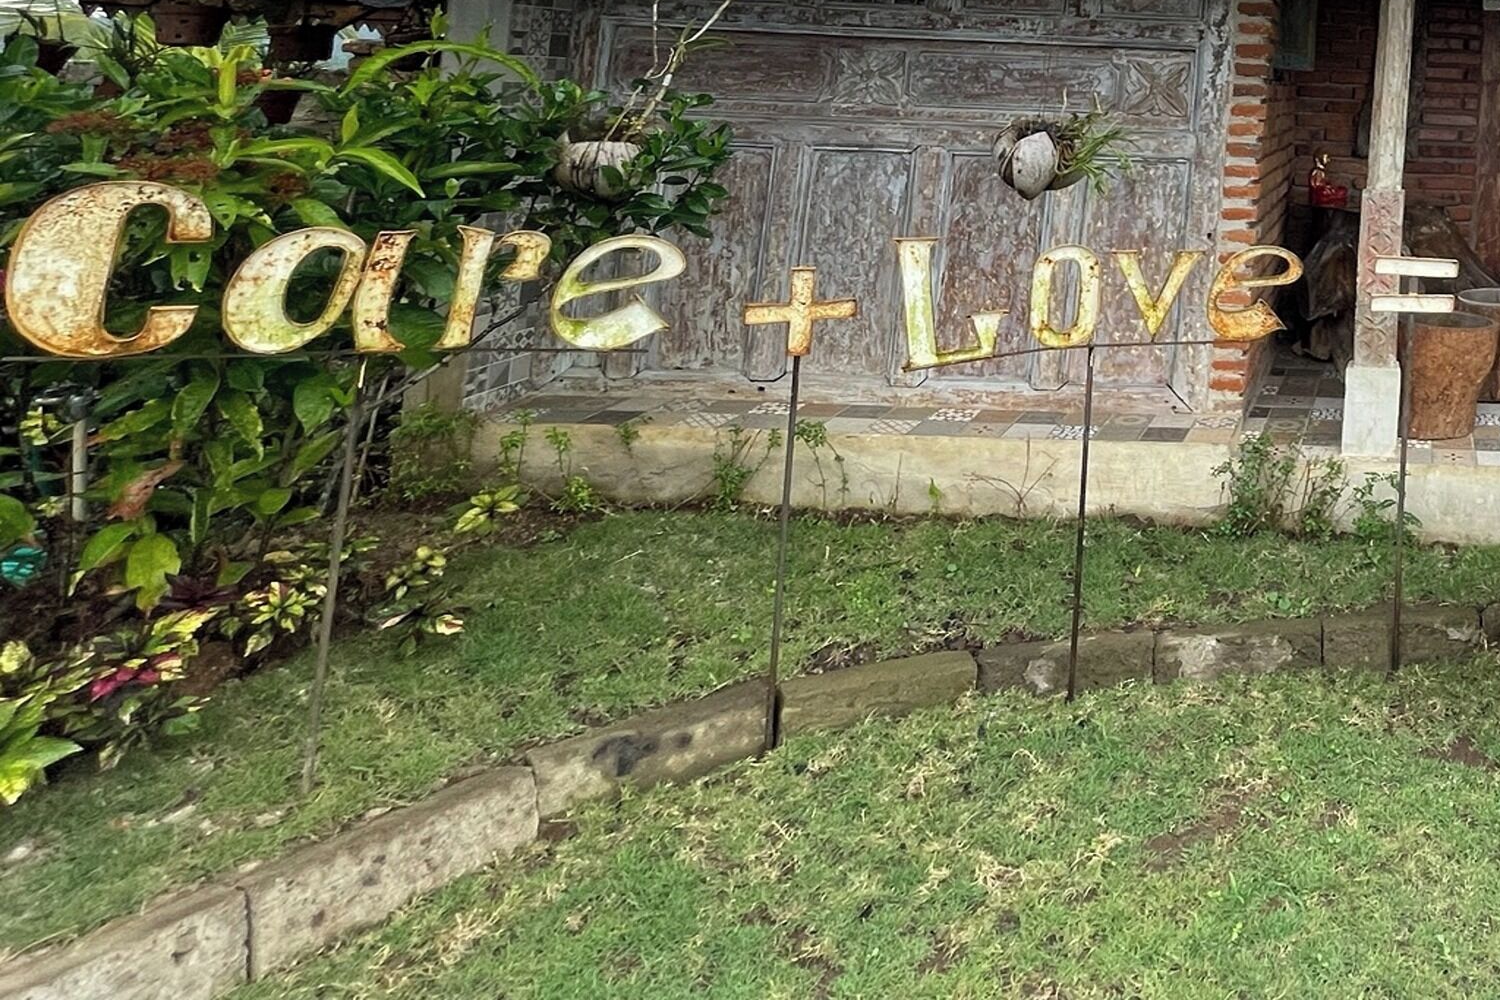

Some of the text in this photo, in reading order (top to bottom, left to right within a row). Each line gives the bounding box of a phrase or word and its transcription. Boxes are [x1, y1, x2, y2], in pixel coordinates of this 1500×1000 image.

[5, 180, 687, 357] Care
[744, 266, 857, 356] +
[894, 237, 1304, 371] Love
